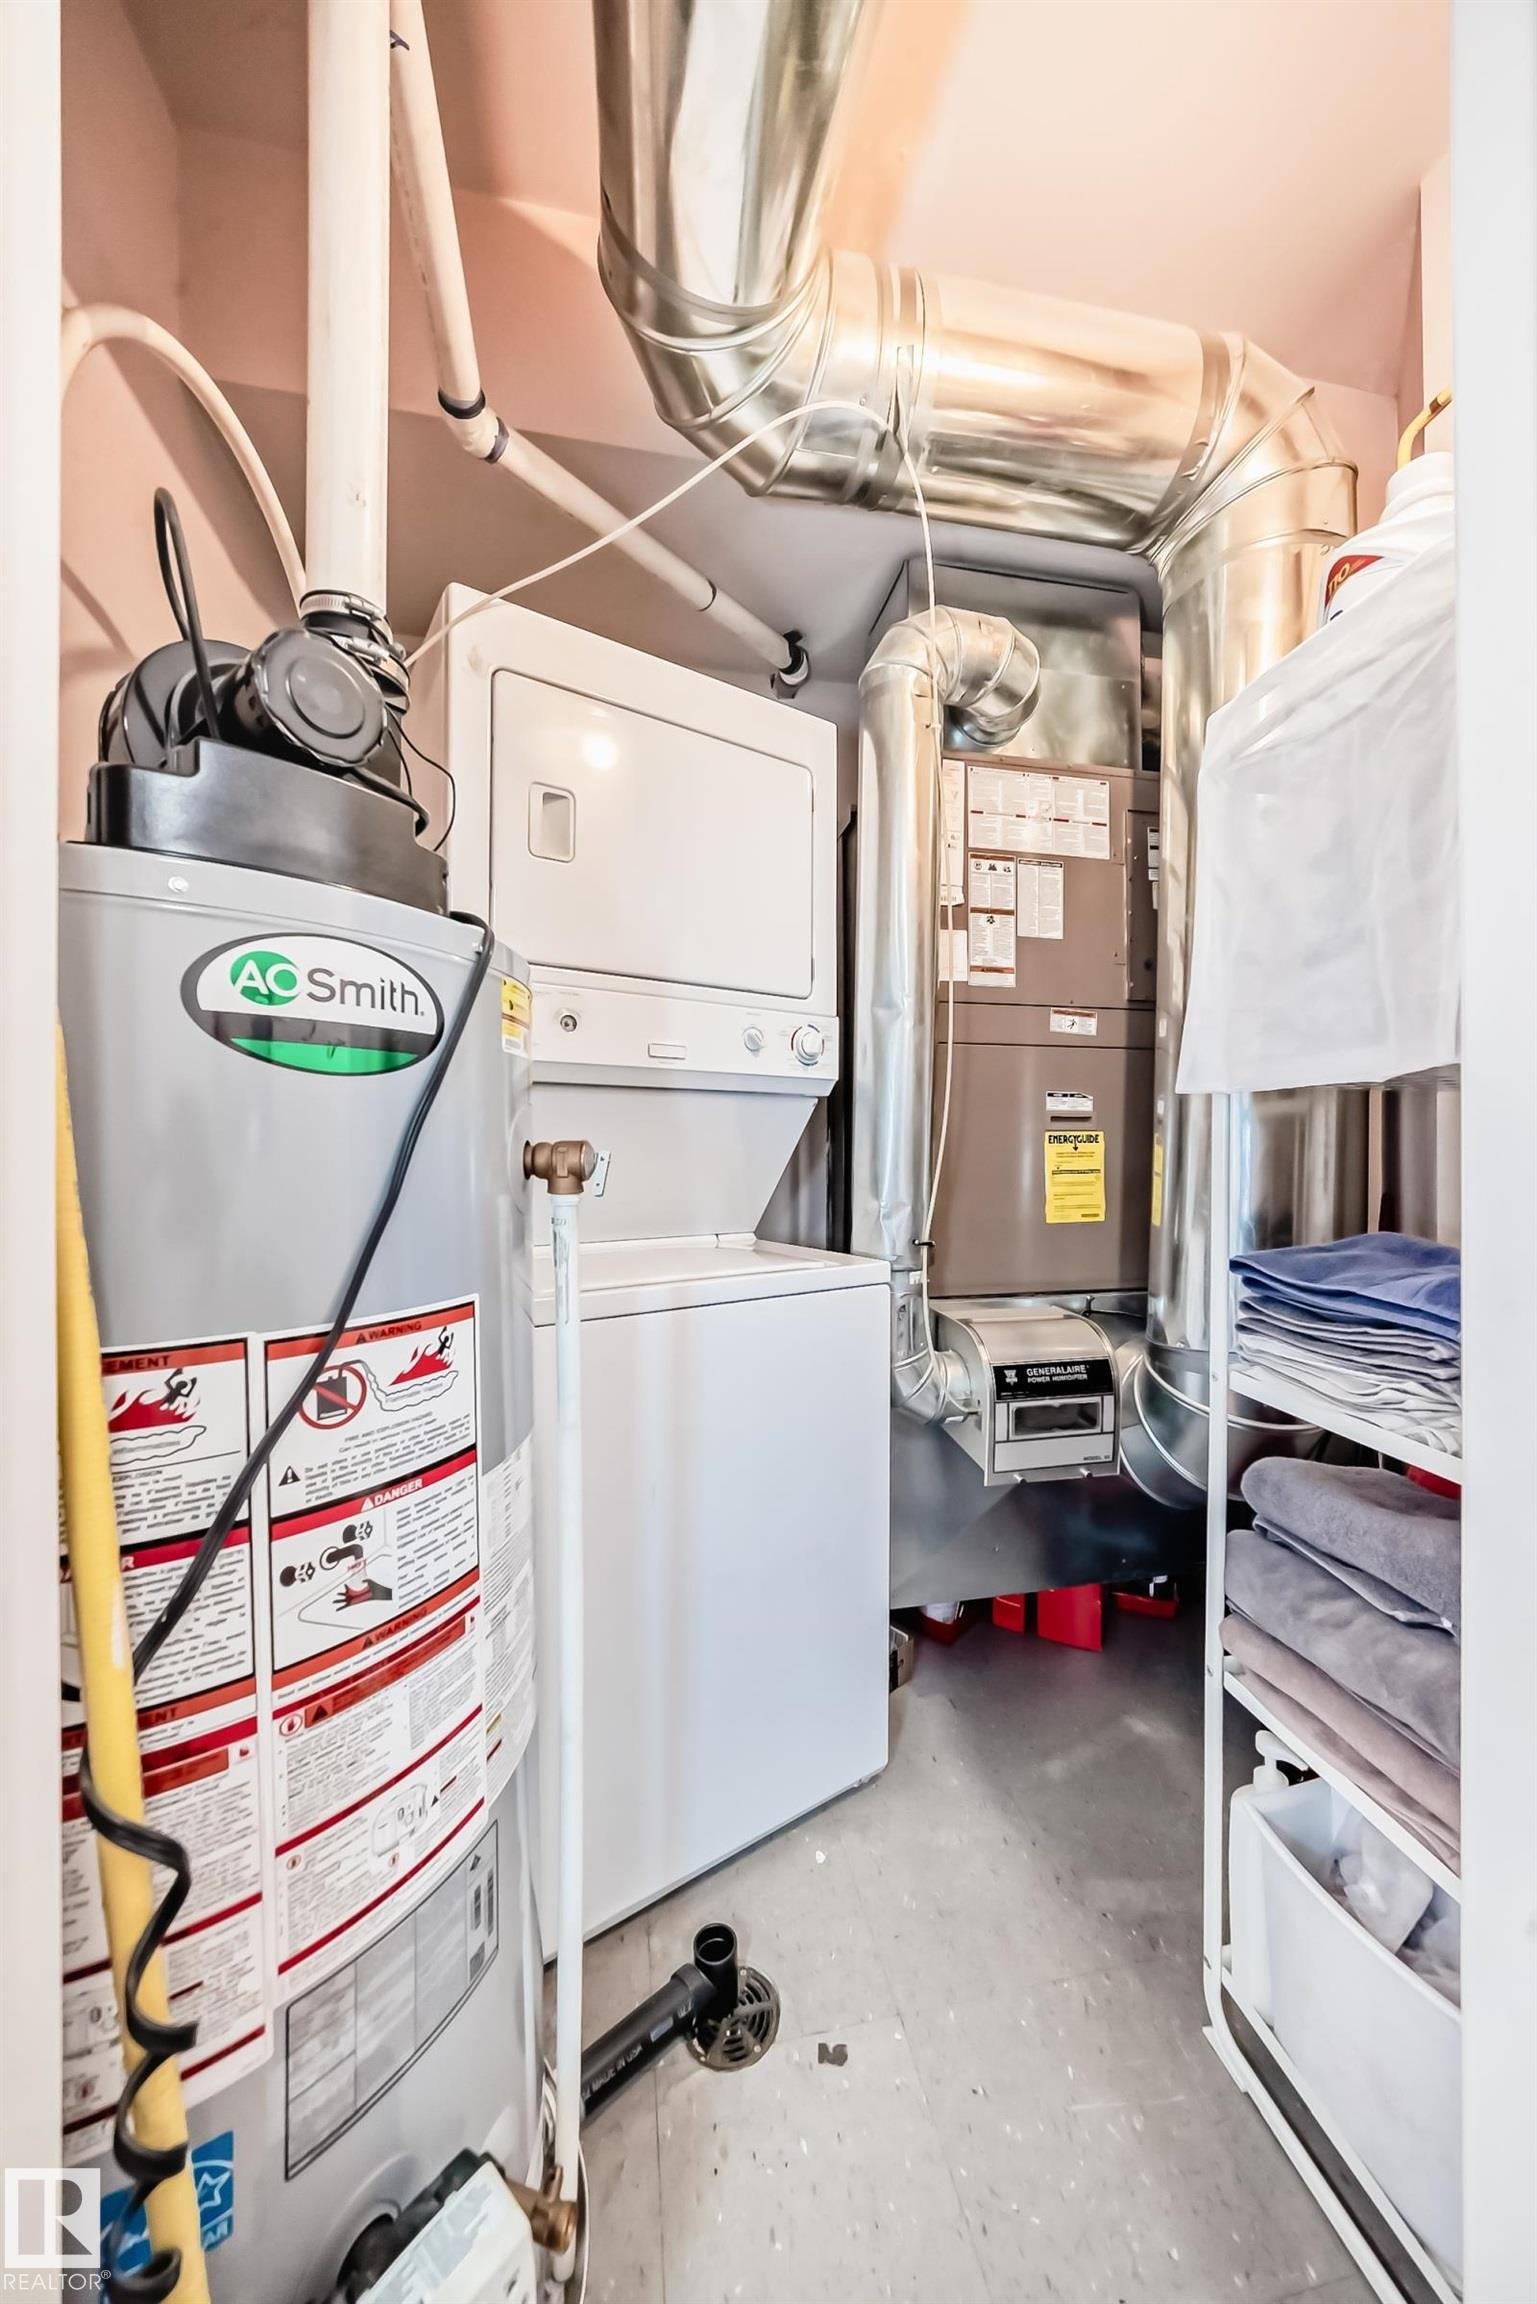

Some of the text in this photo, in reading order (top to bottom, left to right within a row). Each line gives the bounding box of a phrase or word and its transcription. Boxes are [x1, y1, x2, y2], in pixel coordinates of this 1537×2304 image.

[1048, 1134, 1100, 1146] ENERGYGUIDE
[368, 1320, 422, 1341] WARNING
[1026, 1364, 1087, 1377] GENERALAIRE
[1027, 1375, 1050, 1384] POWER
[1052, 1373, 1088, 1382] HUMIDIFIER
[374, 1478, 423, 1507] DANGER
